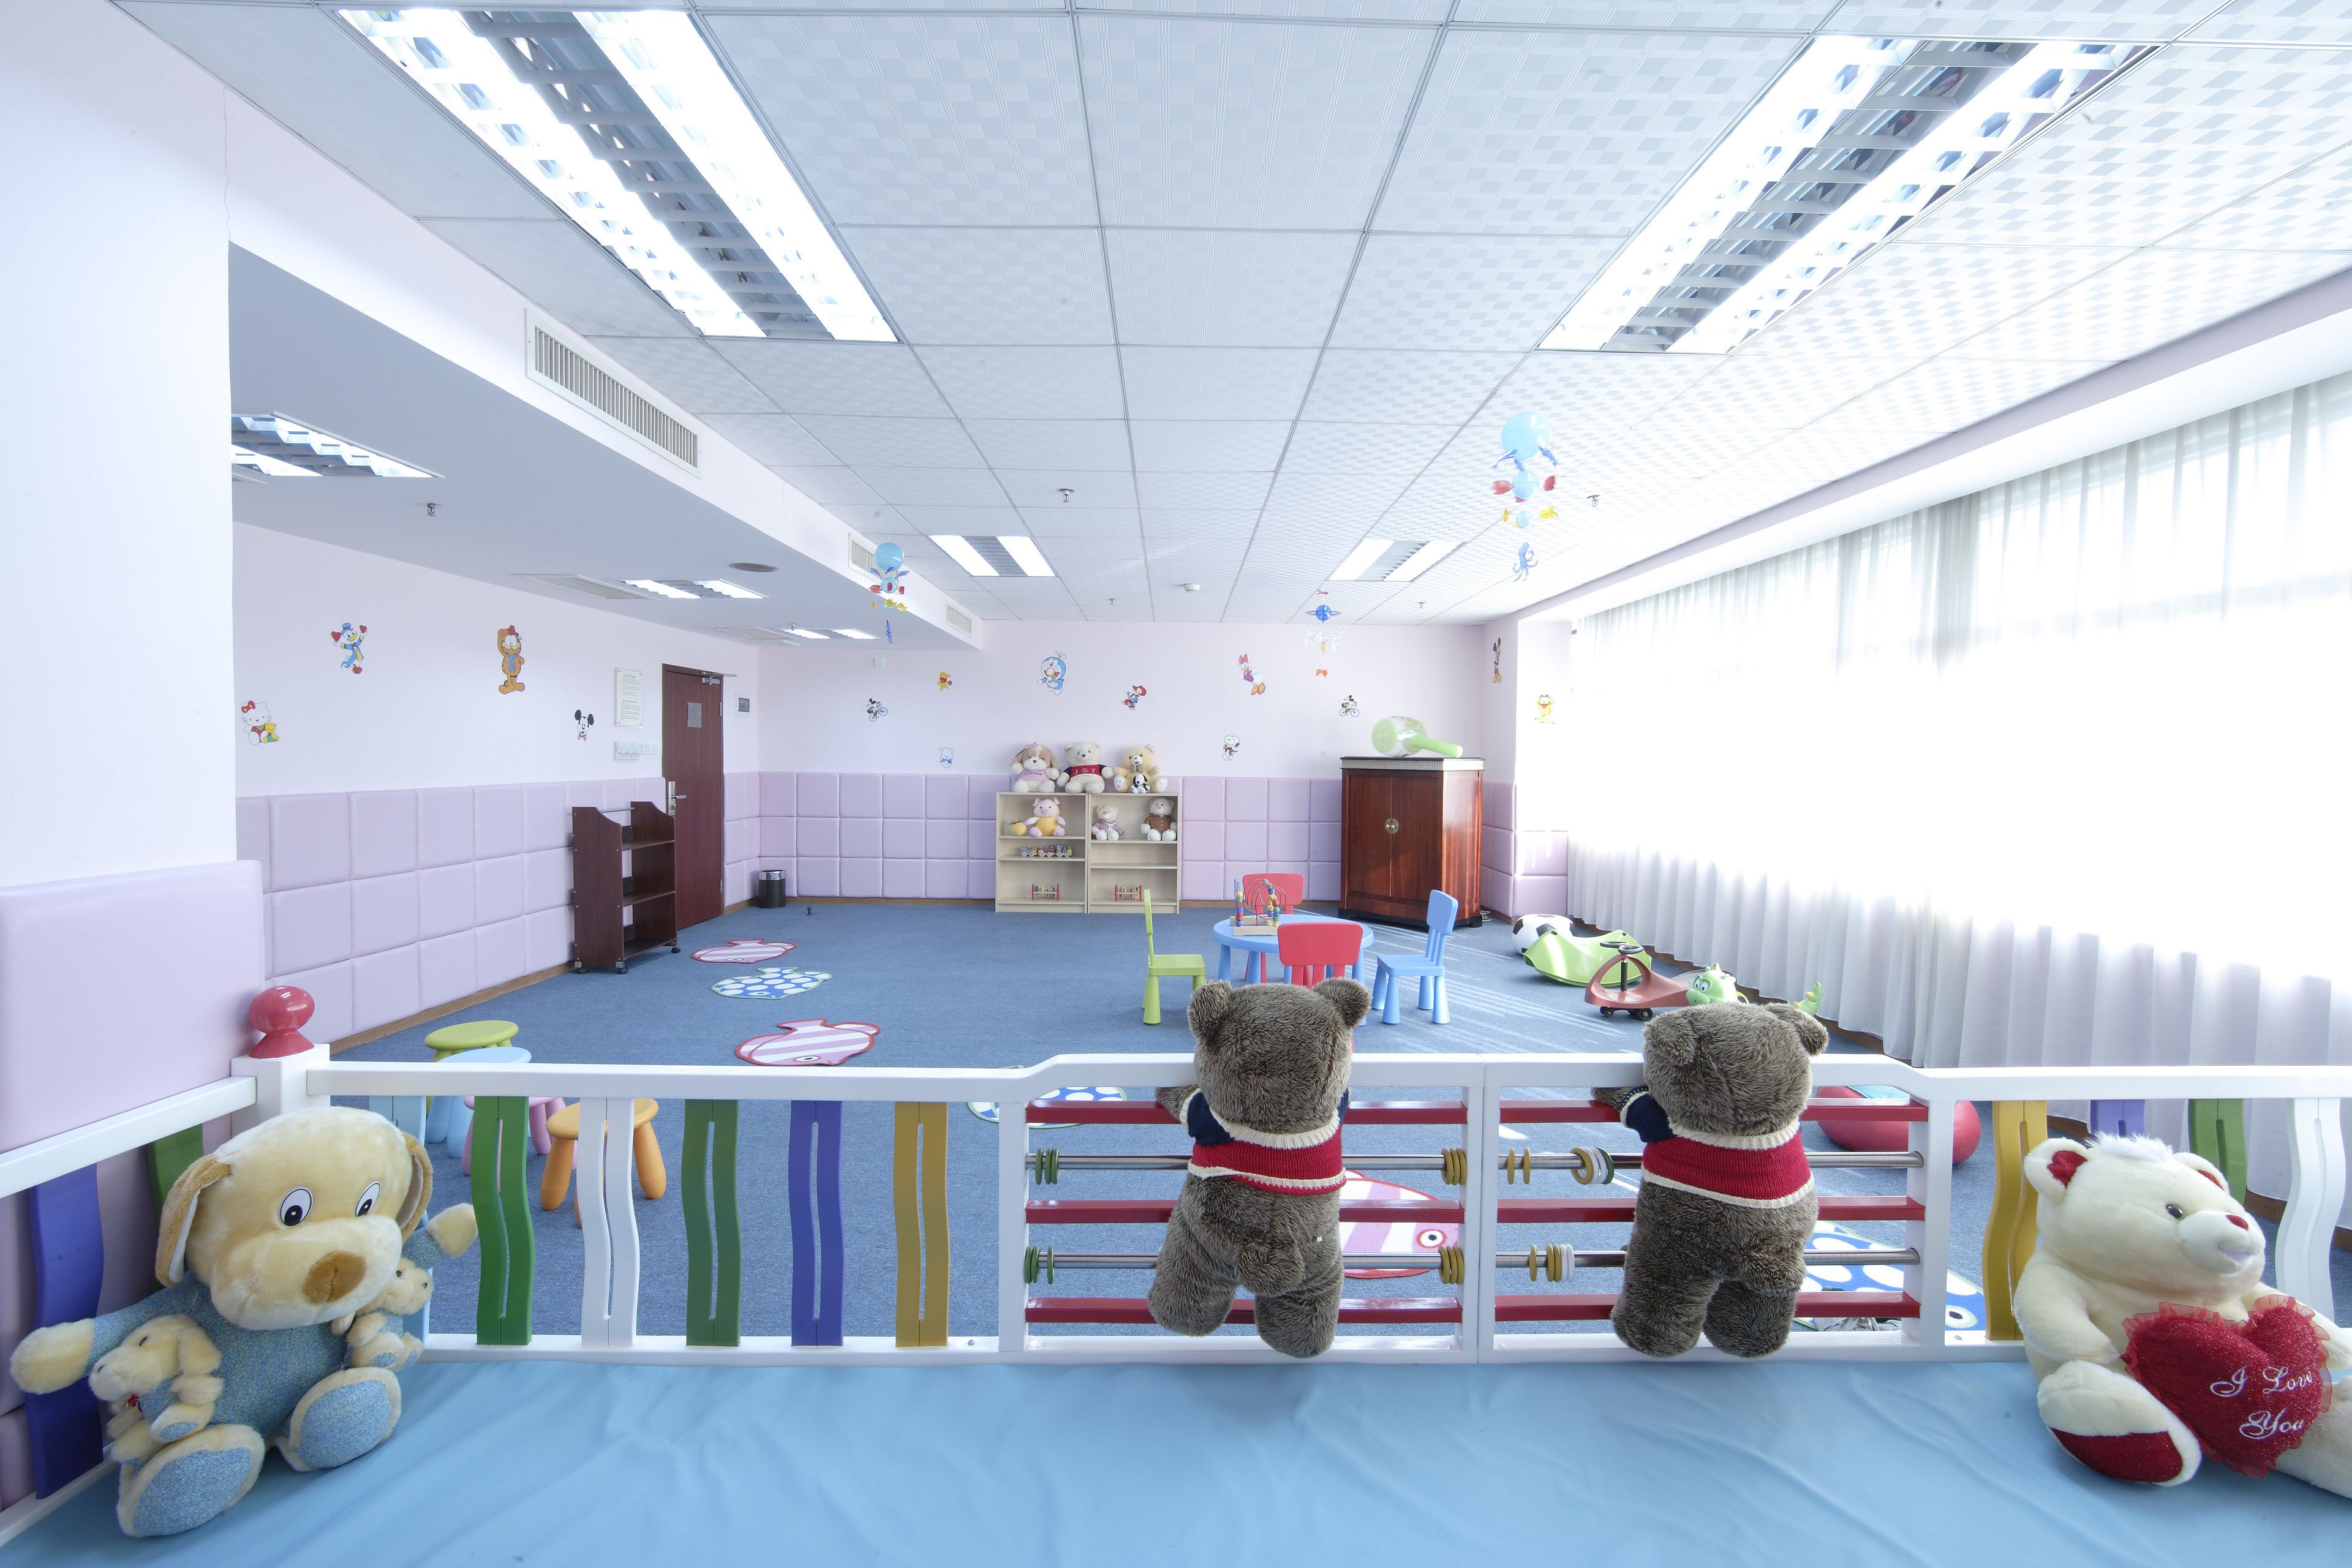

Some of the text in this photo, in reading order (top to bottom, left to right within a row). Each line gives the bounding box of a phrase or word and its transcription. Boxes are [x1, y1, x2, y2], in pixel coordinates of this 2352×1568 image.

[2210, 1365, 2313, 1397] I Love
[2239, 1408, 2305, 1439] You
